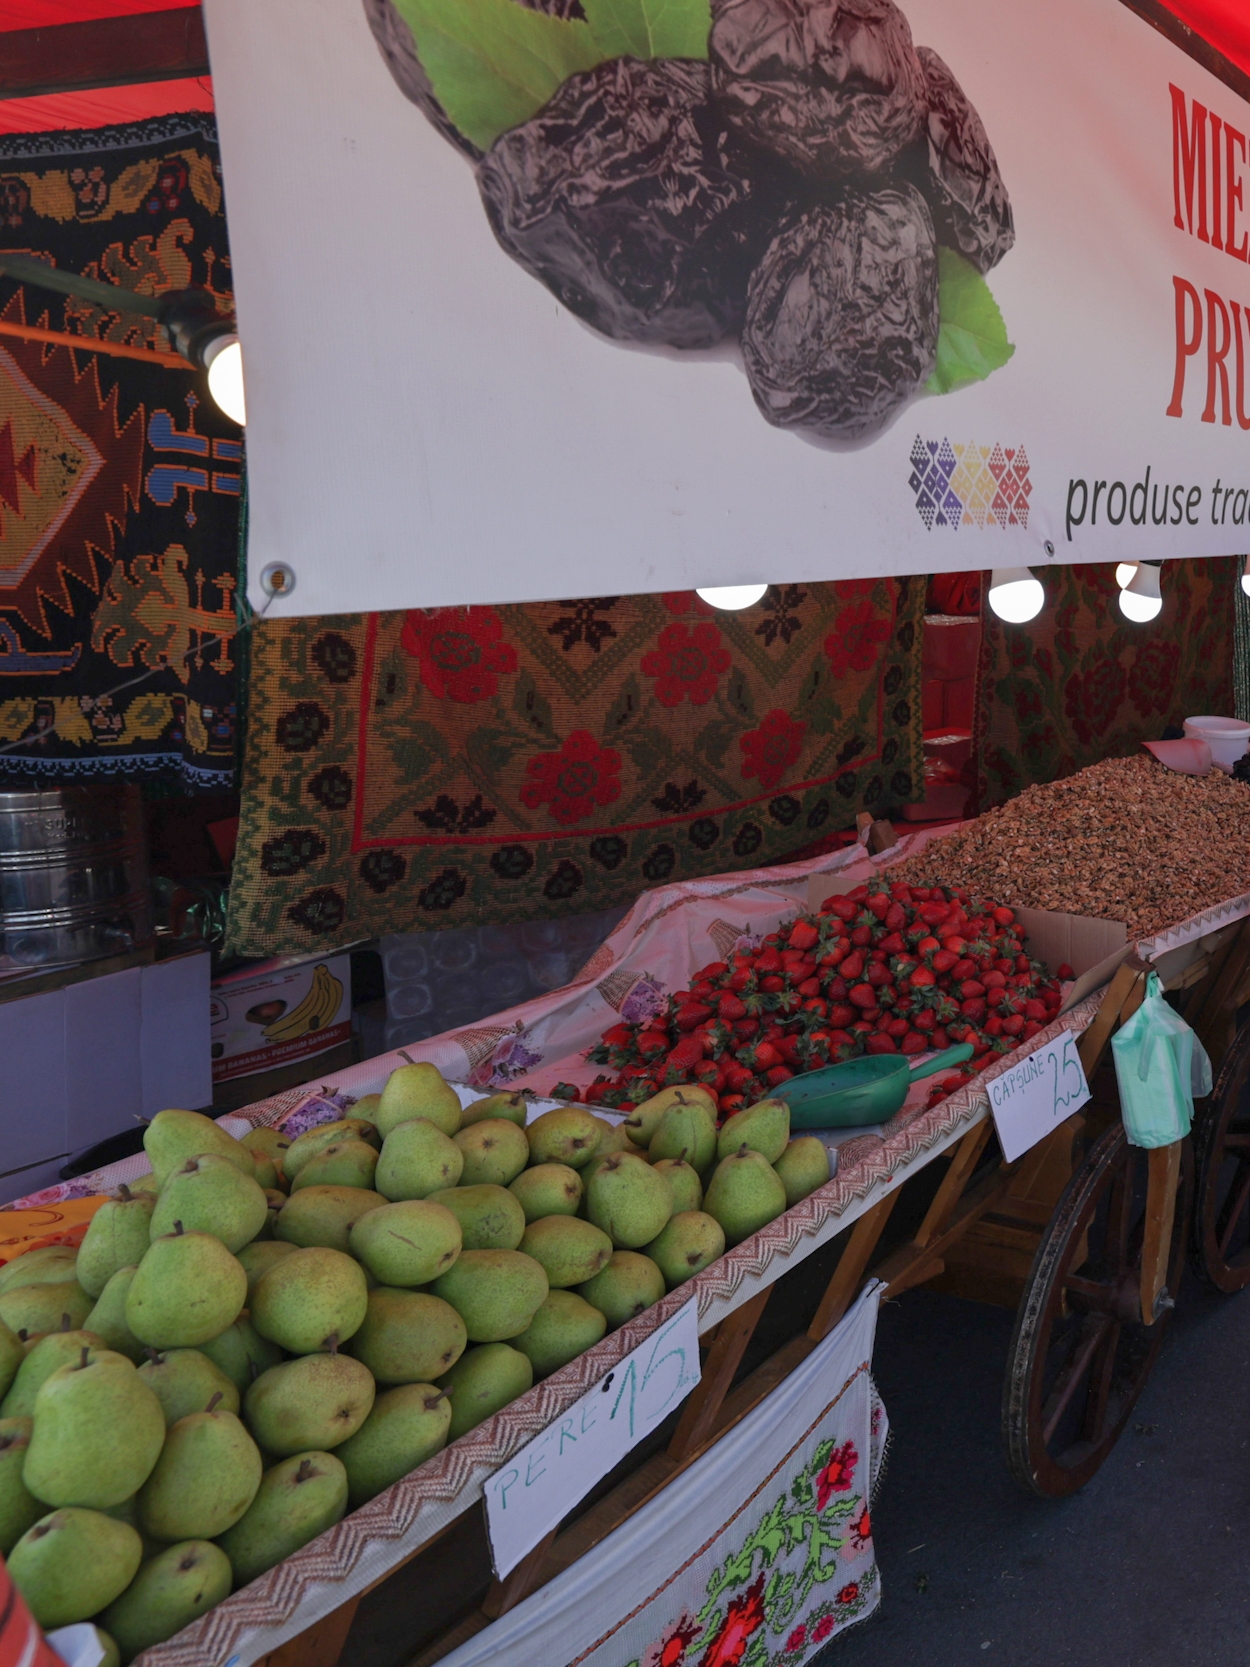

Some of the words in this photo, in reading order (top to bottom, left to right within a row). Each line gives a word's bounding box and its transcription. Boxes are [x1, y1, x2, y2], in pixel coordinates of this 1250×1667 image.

[1065, 465, 1201, 541] produse
[271, 1040, 307, 1057] PREMIUM
[1048, 1038, 1082, 1116] 25
[493, 1390, 601, 1510] PERE
[608, 1308, 689, 1438] 15
